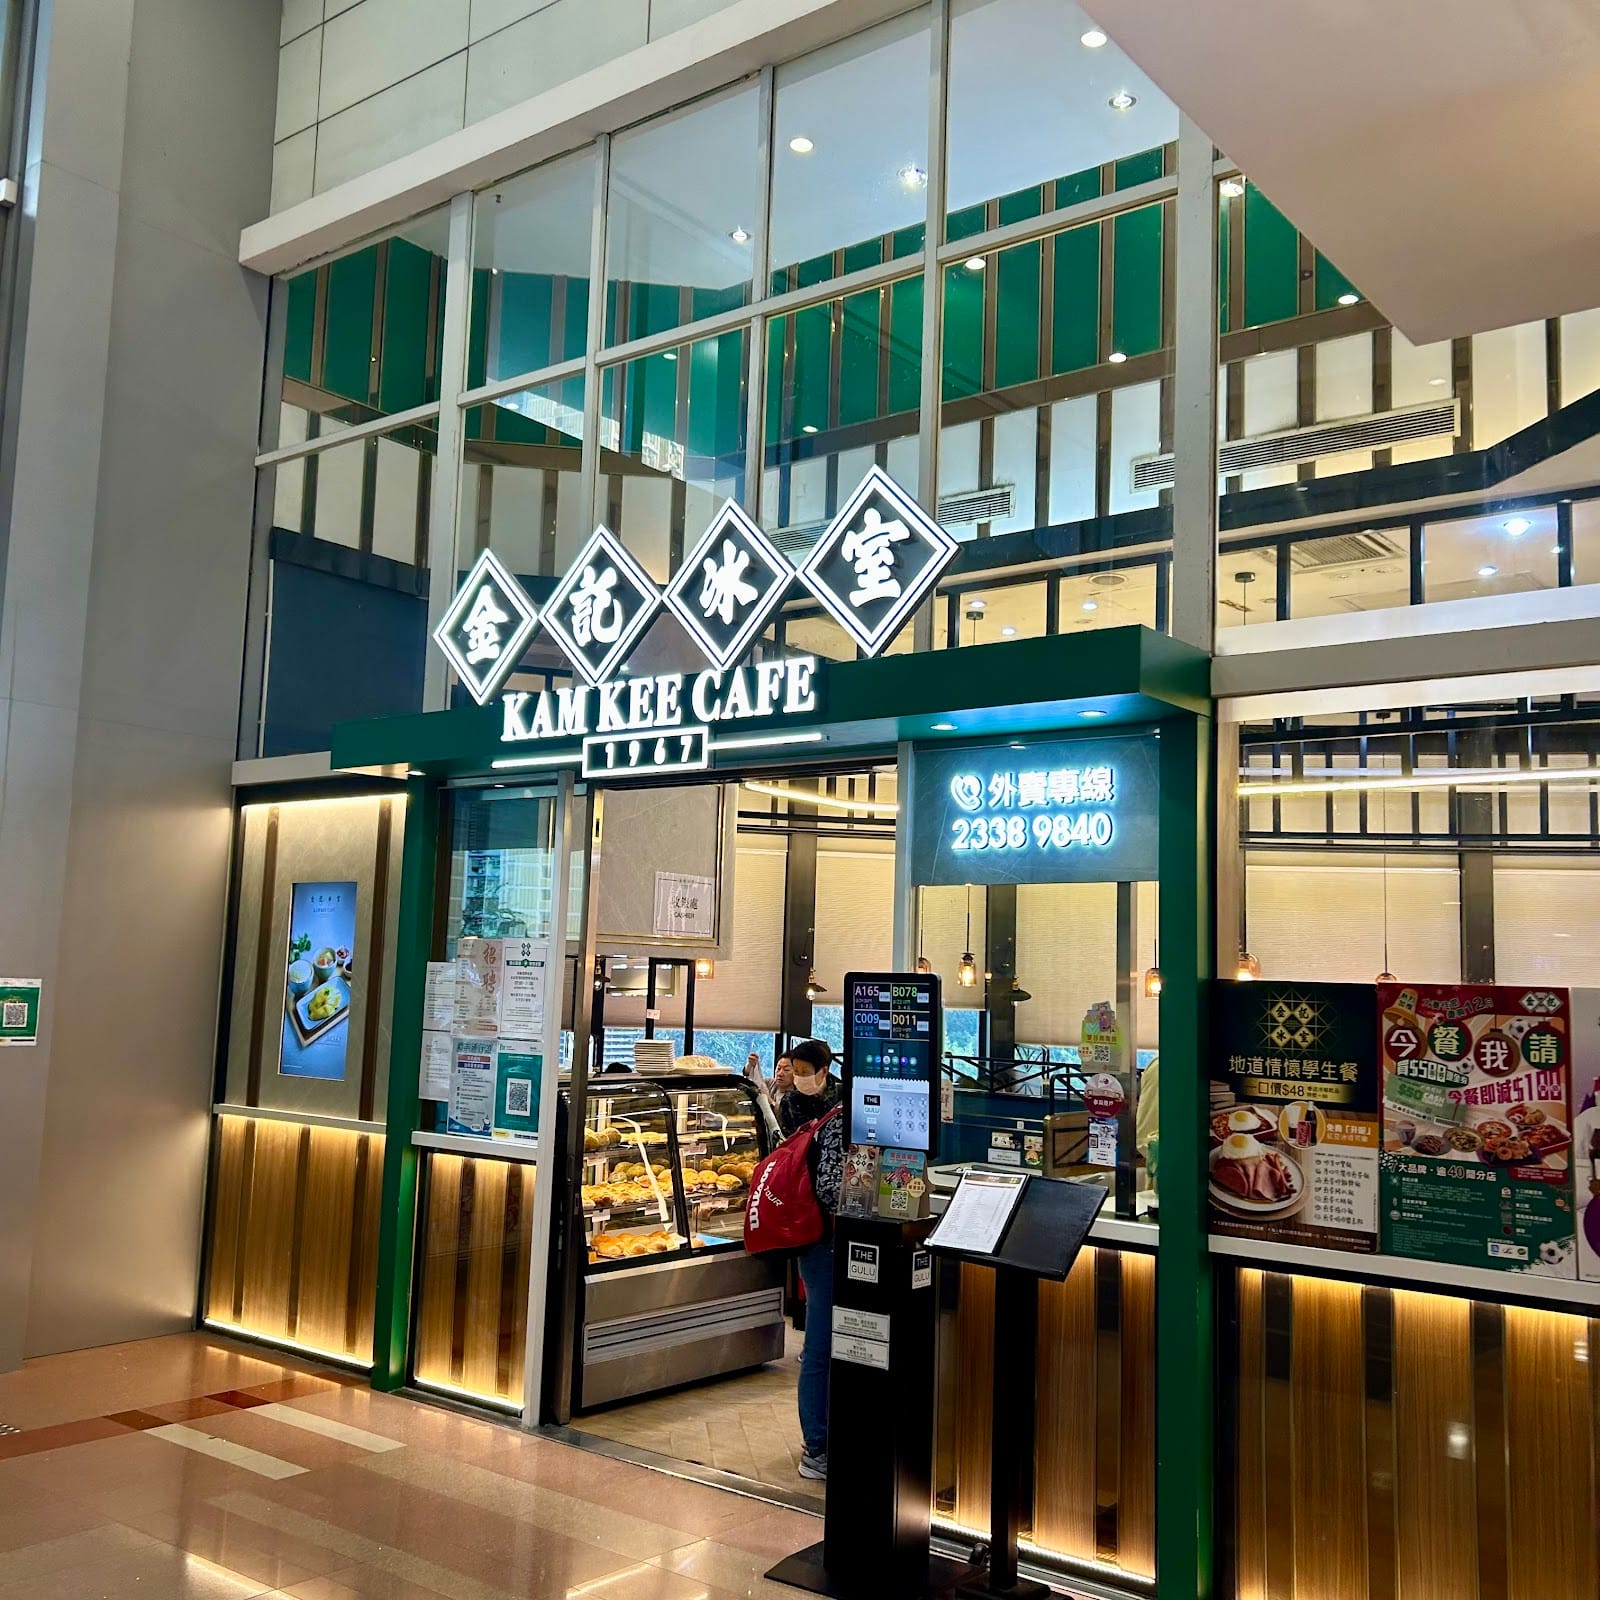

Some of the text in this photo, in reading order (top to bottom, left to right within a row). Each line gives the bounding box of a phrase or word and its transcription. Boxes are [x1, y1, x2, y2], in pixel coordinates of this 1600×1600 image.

[462, 507, 911, 666] 金記冰室
[501, 656, 817, 743] KAM KEE CAFE
[604, 738, 695, 769] 1967
[988, 767, 1115, 808] 外賣專線
[951, 812, 1113, 850] 2338 9840
[482, 943, 497, 993] 招聘
[855, 985, 879, 996] A165
[892, 986, 918, 998] B078
[855, 1013, 879, 1024] C009
[892, 1014, 917, 1026] D011
[1390, 1026, 1558, 1071] 今餐我請
[1229, 1055, 1359, 1083] 地道情懷學生餐
[1246, 1082, 1305, 1097] 一口價$48
[866, 1096, 878, 1104] THE
[763, 1185, 785, 1207] TOUR
[854, 1249, 873, 1261] THE
[916, 1258, 929, 1267] THE
[851, 1264, 876, 1277] GULU
[913, 1270, 930, 1283] GULU
